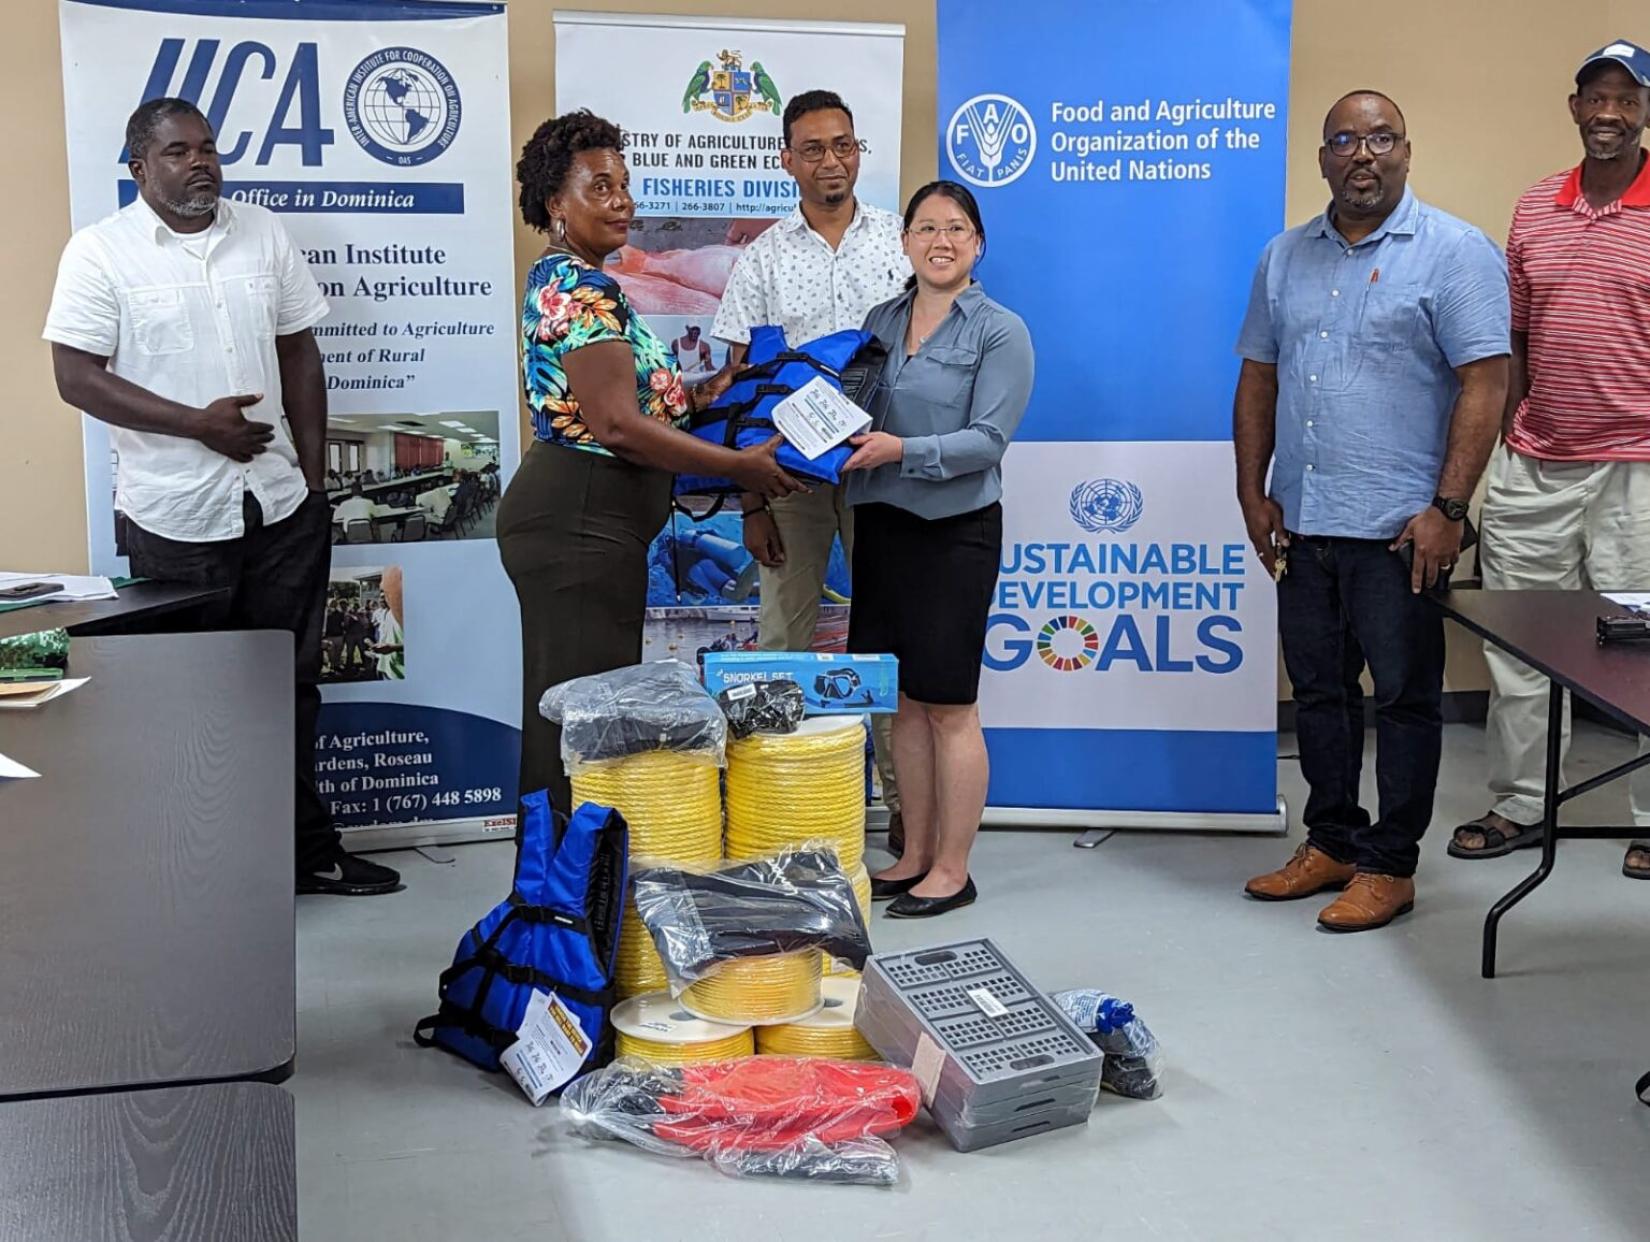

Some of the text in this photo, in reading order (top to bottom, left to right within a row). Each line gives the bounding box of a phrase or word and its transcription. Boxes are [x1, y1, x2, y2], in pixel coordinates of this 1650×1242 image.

[352, 55, 384, 83] INSTITUTE
[384, 50, 401, 61] FOR
[402, 50, 448, 84] COOPERATION
[1051, 98, 1276, 126] Food and Agriculture
[665, 134, 683, 148] OF
[1051, 128, 1260, 158] Organization of the
[633, 152, 669, 167] BLUE
[675, 153, 703, 168] AND
[710, 154, 757, 169] GREEN
[956, 148, 1027, 178] FIAT PANIS
[1051, 159, 1211, 182] United Nations
[643, 178, 735, 197] FISHERIES
[295, 189, 314, 206] in
[321, 190, 415, 208] Dominica
[682, 202, 725, 211] 266-3807
[345, 244, 446, 264] Institute
[353, 276, 492, 302] Agriculture
[383, 324, 398, 336] to
[402, 322, 495, 340] Agriculture
[357, 349, 376, 363] of
[379, 348, 425, 363] Rural
[992, 581, 1244, 610] EVELOPMENT
[982, 613, 1244, 674] GOALS
[329, 730, 429, 751] Agriculture,
[315, 753, 433, 772] rdens, Roseau
[340, 777, 359, 792] of
[361, 772, 439, 791] Dominica
[329, 787, 502, 815] Fax: 1 (767) 448 5898
